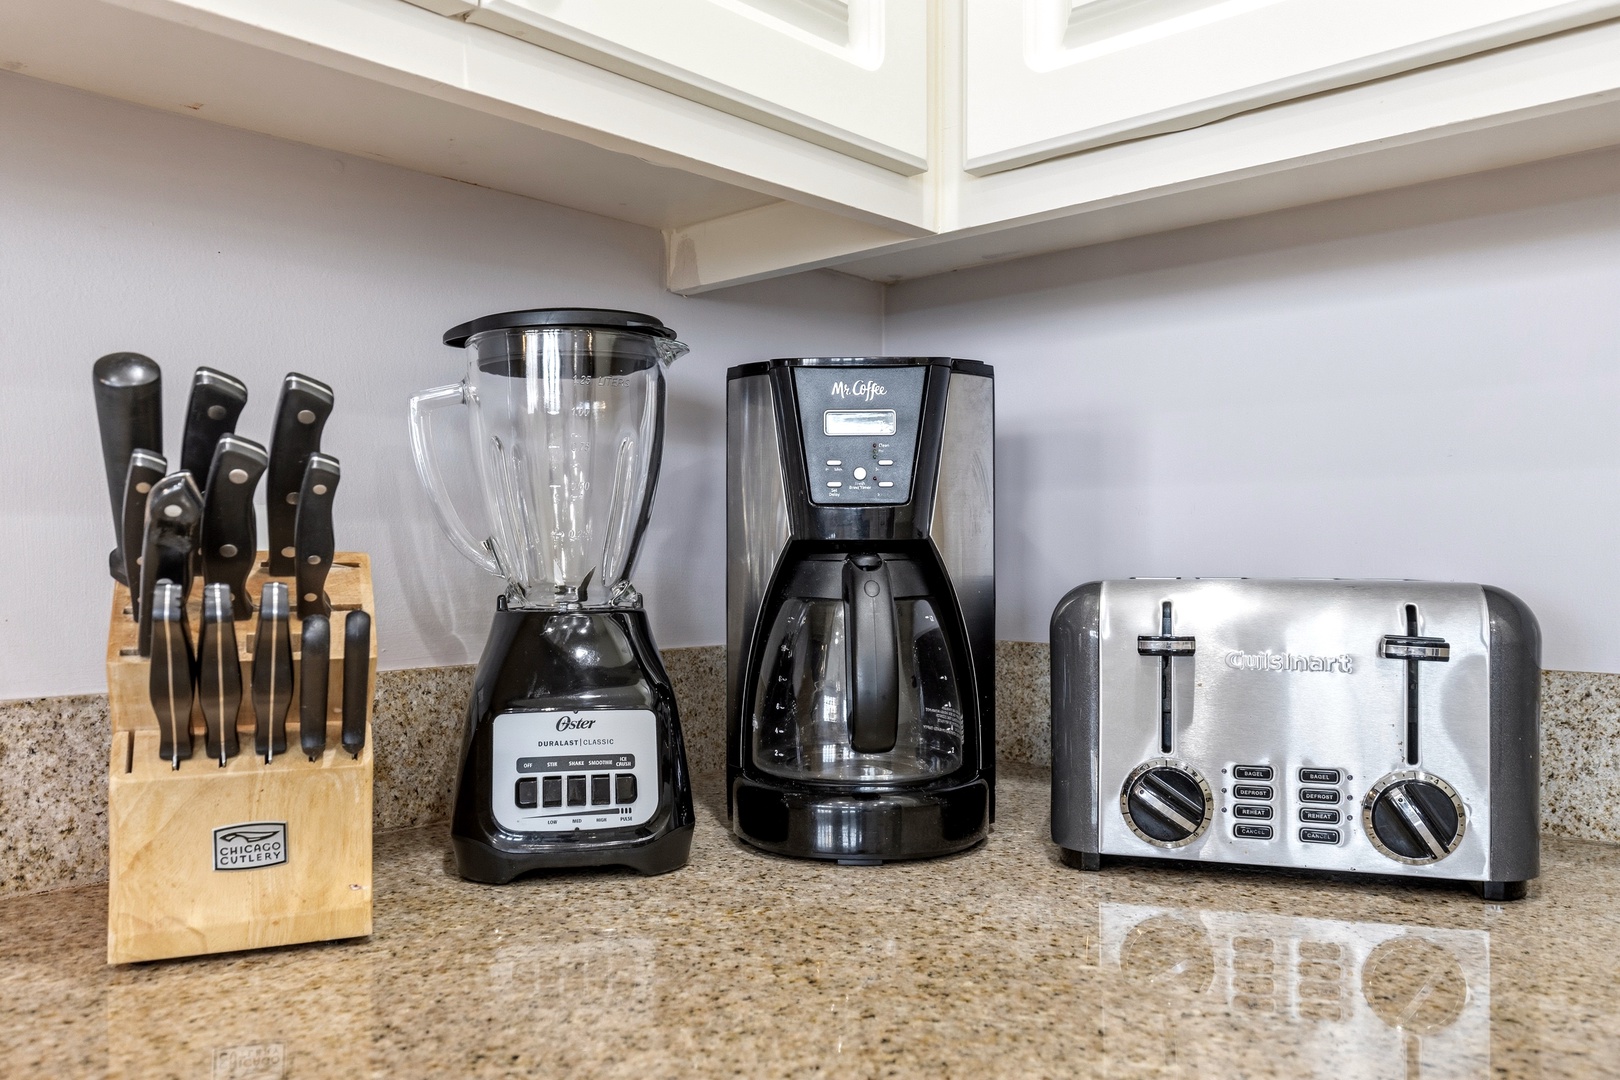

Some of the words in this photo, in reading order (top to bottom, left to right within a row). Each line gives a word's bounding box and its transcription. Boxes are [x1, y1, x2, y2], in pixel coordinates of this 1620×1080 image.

[598, 375, 630, 388] LITERS
[831, 381, 851, 399] Mr.
[852, 379, 887, 401] Coffee
[1224, 650, 1353, 674] Cuisinart
[555, 715, 596, 732] Oster
[537, 739, 579, 747] DURALAST
[582, 738, 615, 746] CLASSIC
[1307, 832, 1331, 840] CANCEL
[220, 842, 281, 856] CHICAGO
[219, 851, 281, 865] CUTLERY
